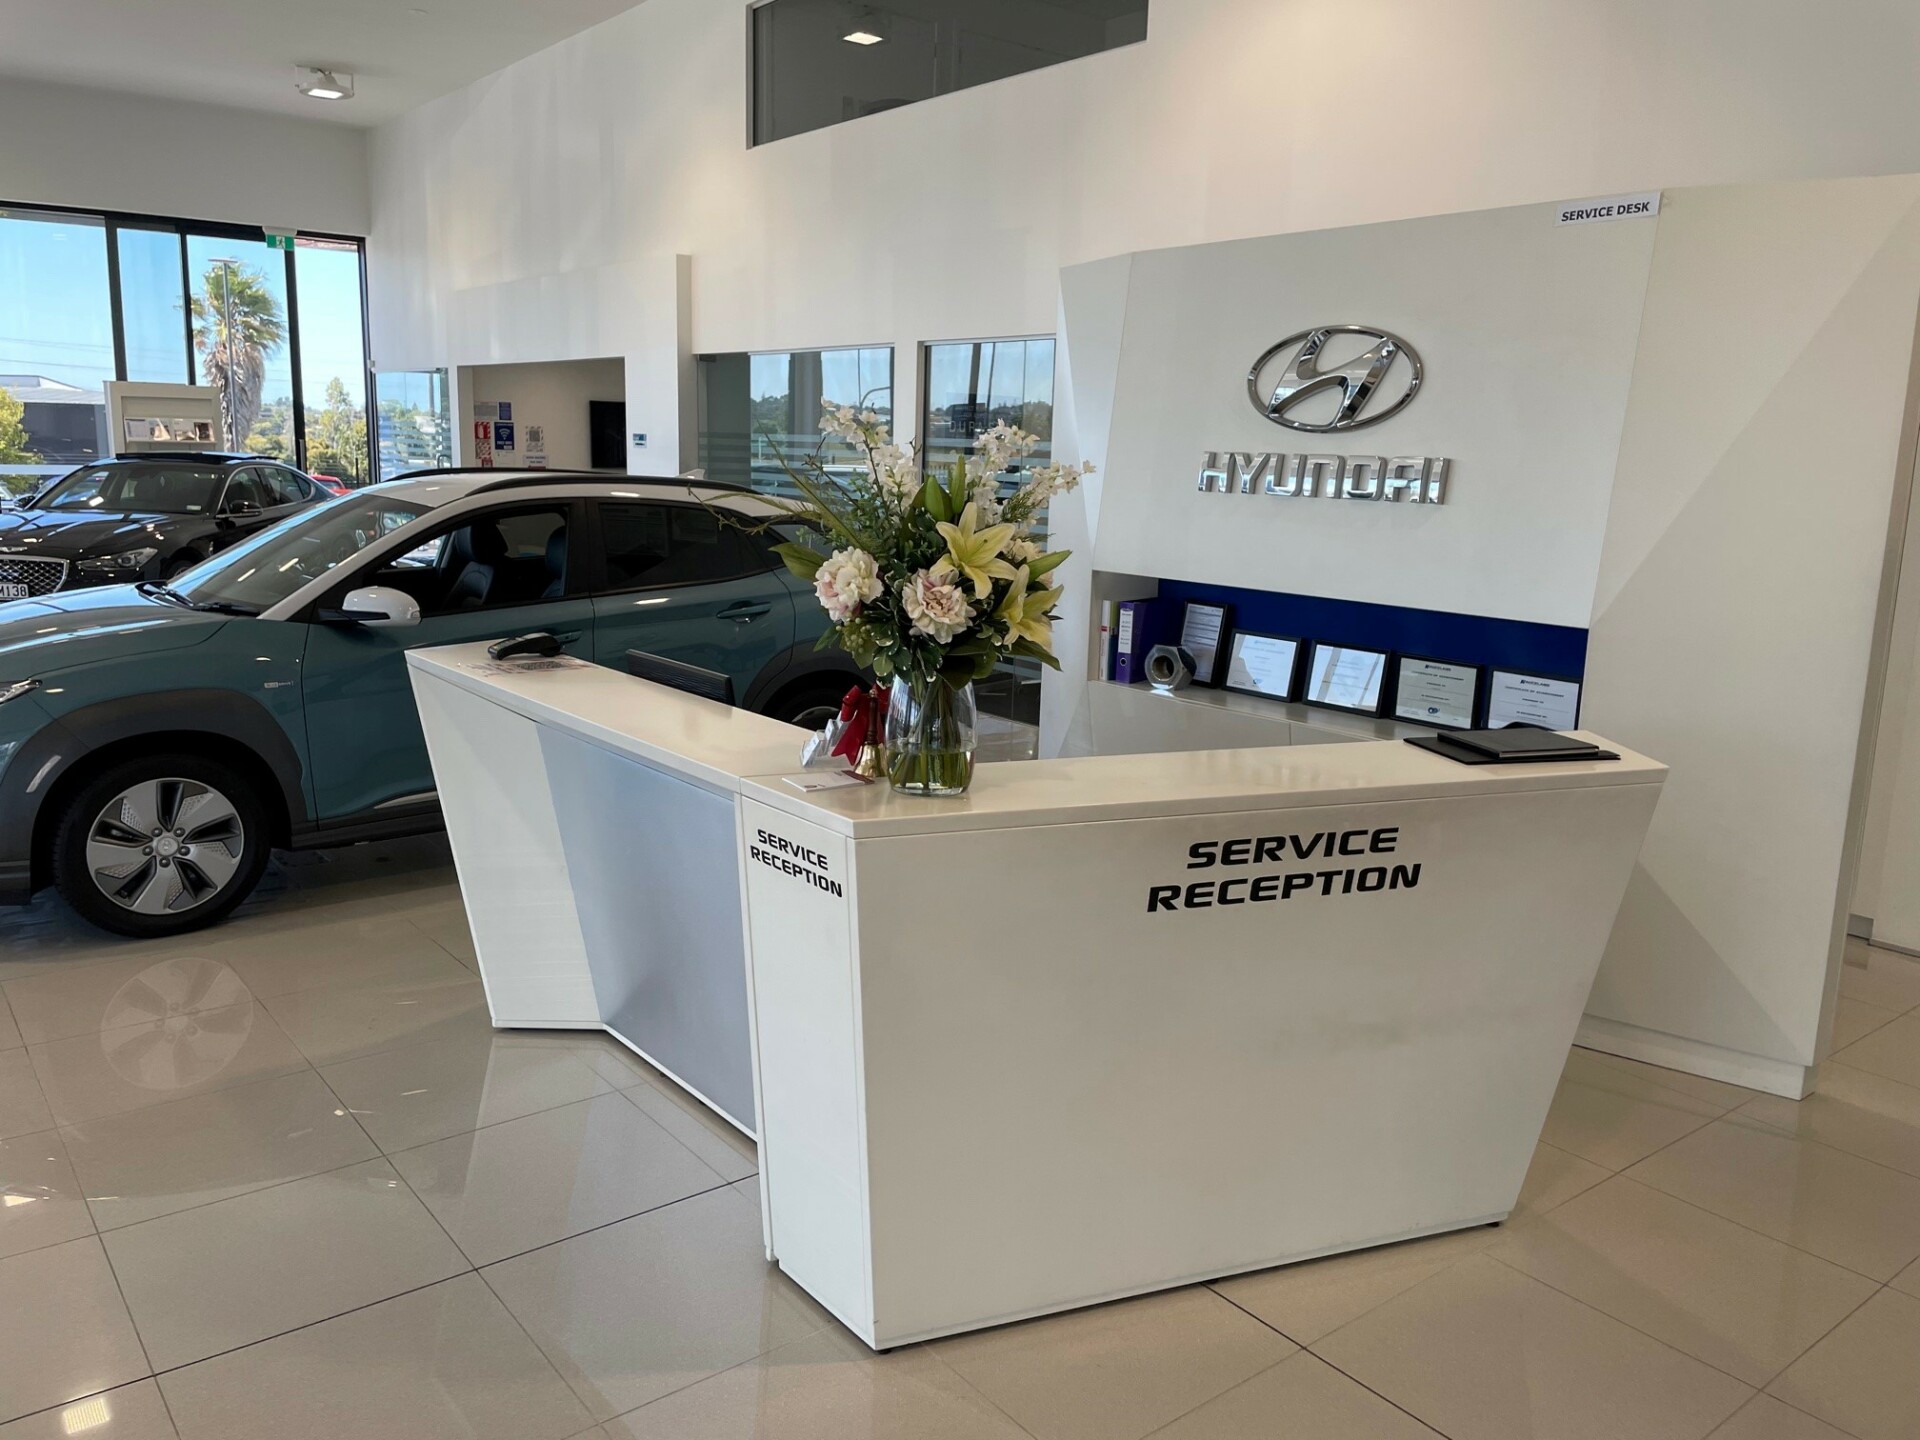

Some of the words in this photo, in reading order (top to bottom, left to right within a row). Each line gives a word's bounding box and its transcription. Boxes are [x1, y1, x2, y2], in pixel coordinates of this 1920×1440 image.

[1561, 206, 1614, 222] SERVICE
[1617, 202, 1650, 215] DESK
[1198, 451, 1450, 505] HYUNDAI
[757, 828, 829, 871] SERVICE
[1187, 827, 1399, 869] SERVICE
[750, 845, 842, 898] RECEPTION
[1147, 863, 1422, 912] RECEPTION
